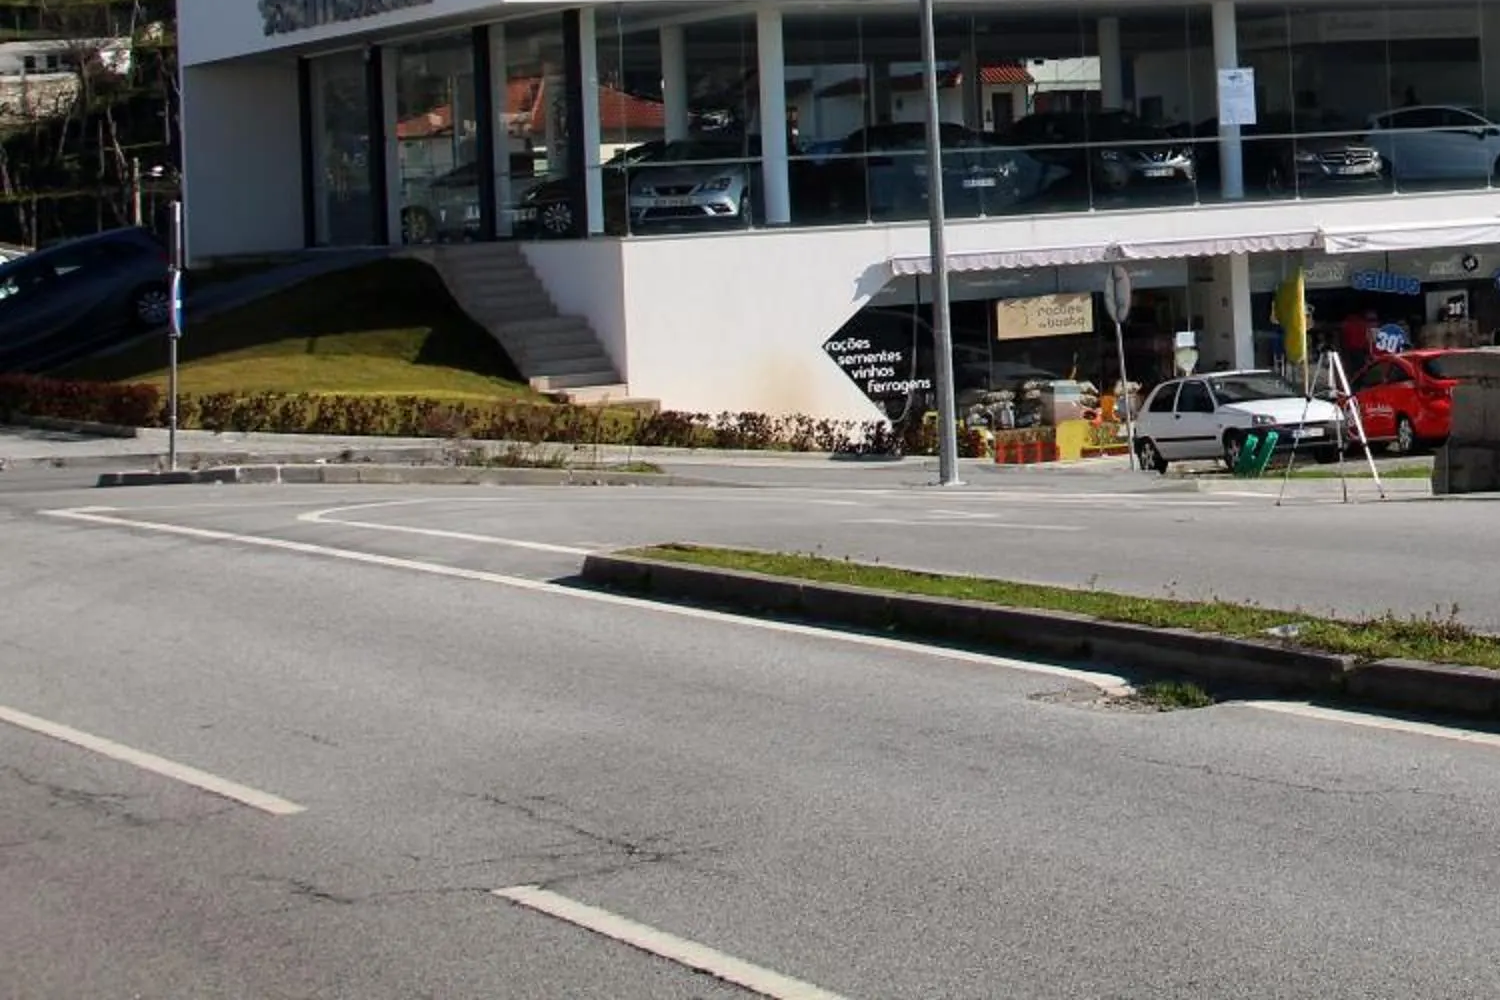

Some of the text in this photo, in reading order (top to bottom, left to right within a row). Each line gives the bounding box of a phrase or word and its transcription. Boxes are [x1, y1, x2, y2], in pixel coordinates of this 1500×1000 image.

[825, 337, 871, 352] rações
[837, 350, 902, 366] sementes
[851, 364, 895, 379] vinhos
[867, 379, 931, 395] ferragens
